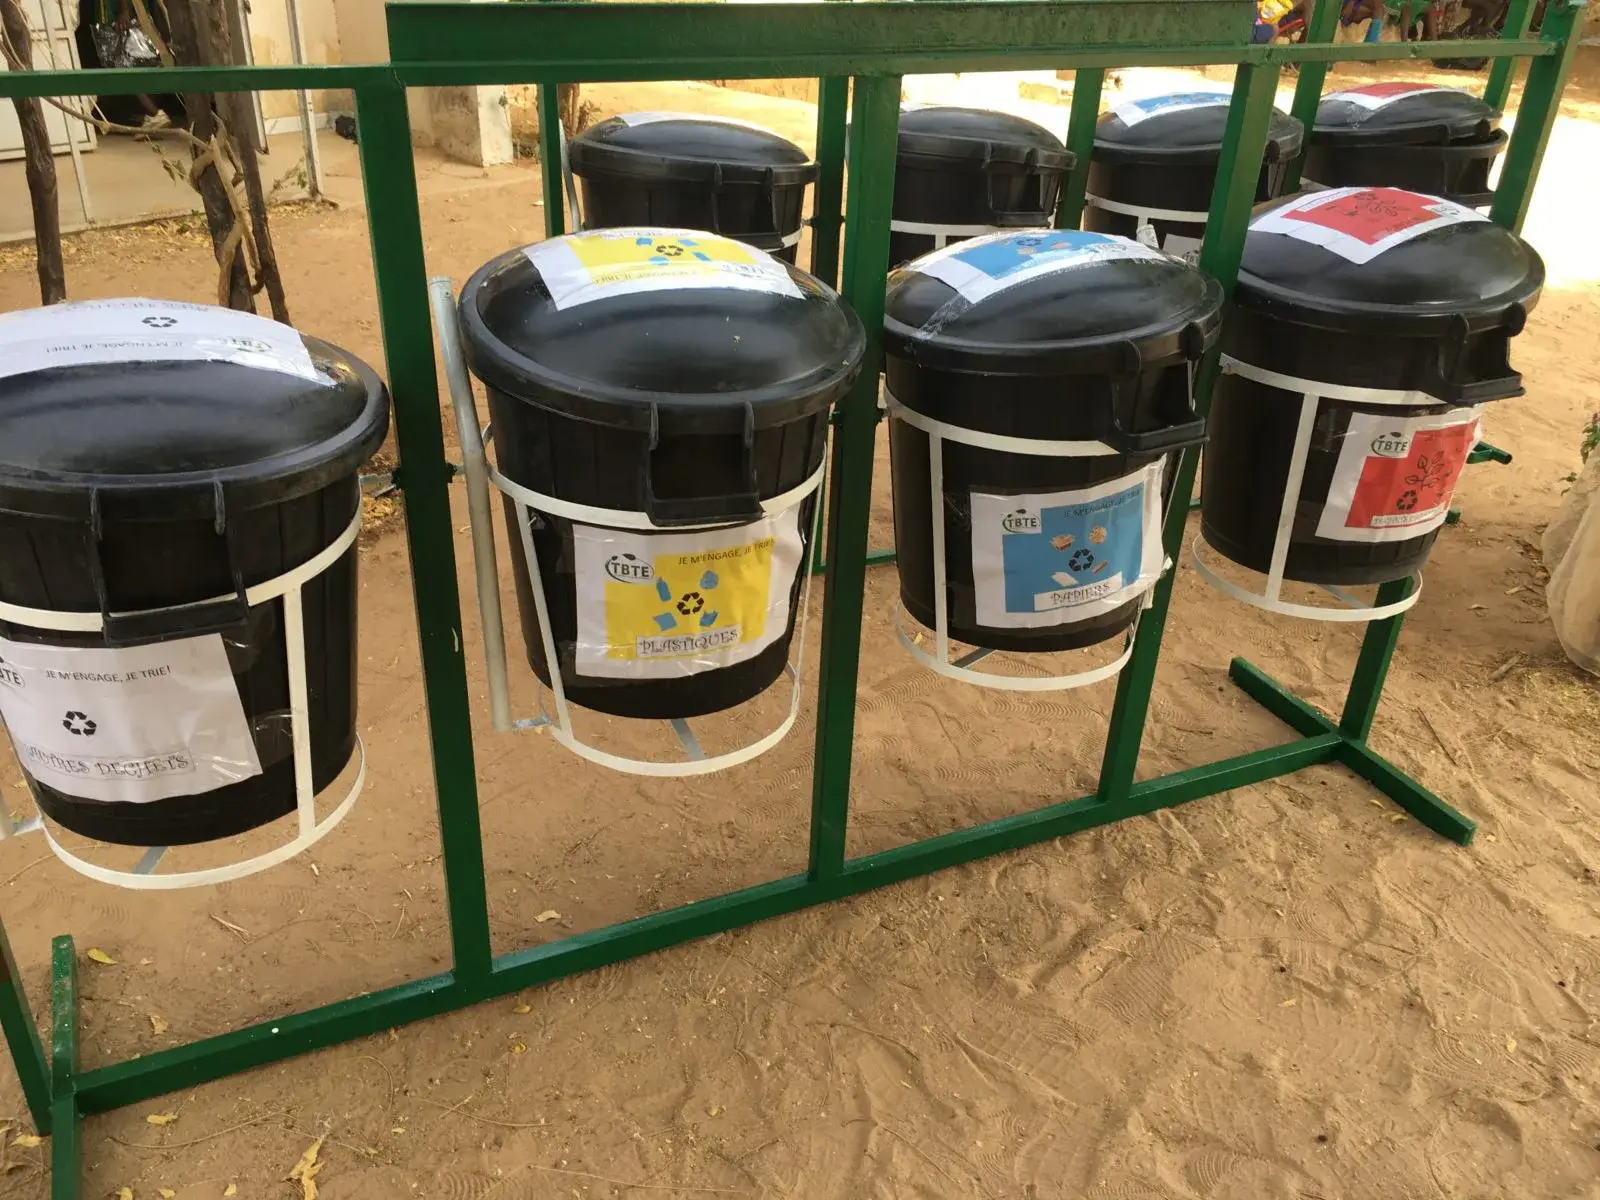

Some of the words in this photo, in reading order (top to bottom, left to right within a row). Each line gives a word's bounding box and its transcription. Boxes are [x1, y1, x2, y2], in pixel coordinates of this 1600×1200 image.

[1377, 439, 1408, 451] TBTE
[1008, 516, 1037, 528] TBTE
[678, 556, 688, 565] JE
[690, 548, 741, 564] M'ENGAGE,
[744, 545, 752, 555] JE
[611, 562, 650, 578] TBTE
[637, 630, 738, 655] PLASTIQUES
[46, 669, 57, 679] JE
[58, 671, 123, 683] M'ENGAGE,
[126, 671, 138, 681] JE
[140, 664, 171, 679] TRIE!
[94, 754, 189, 779] DECHETS
